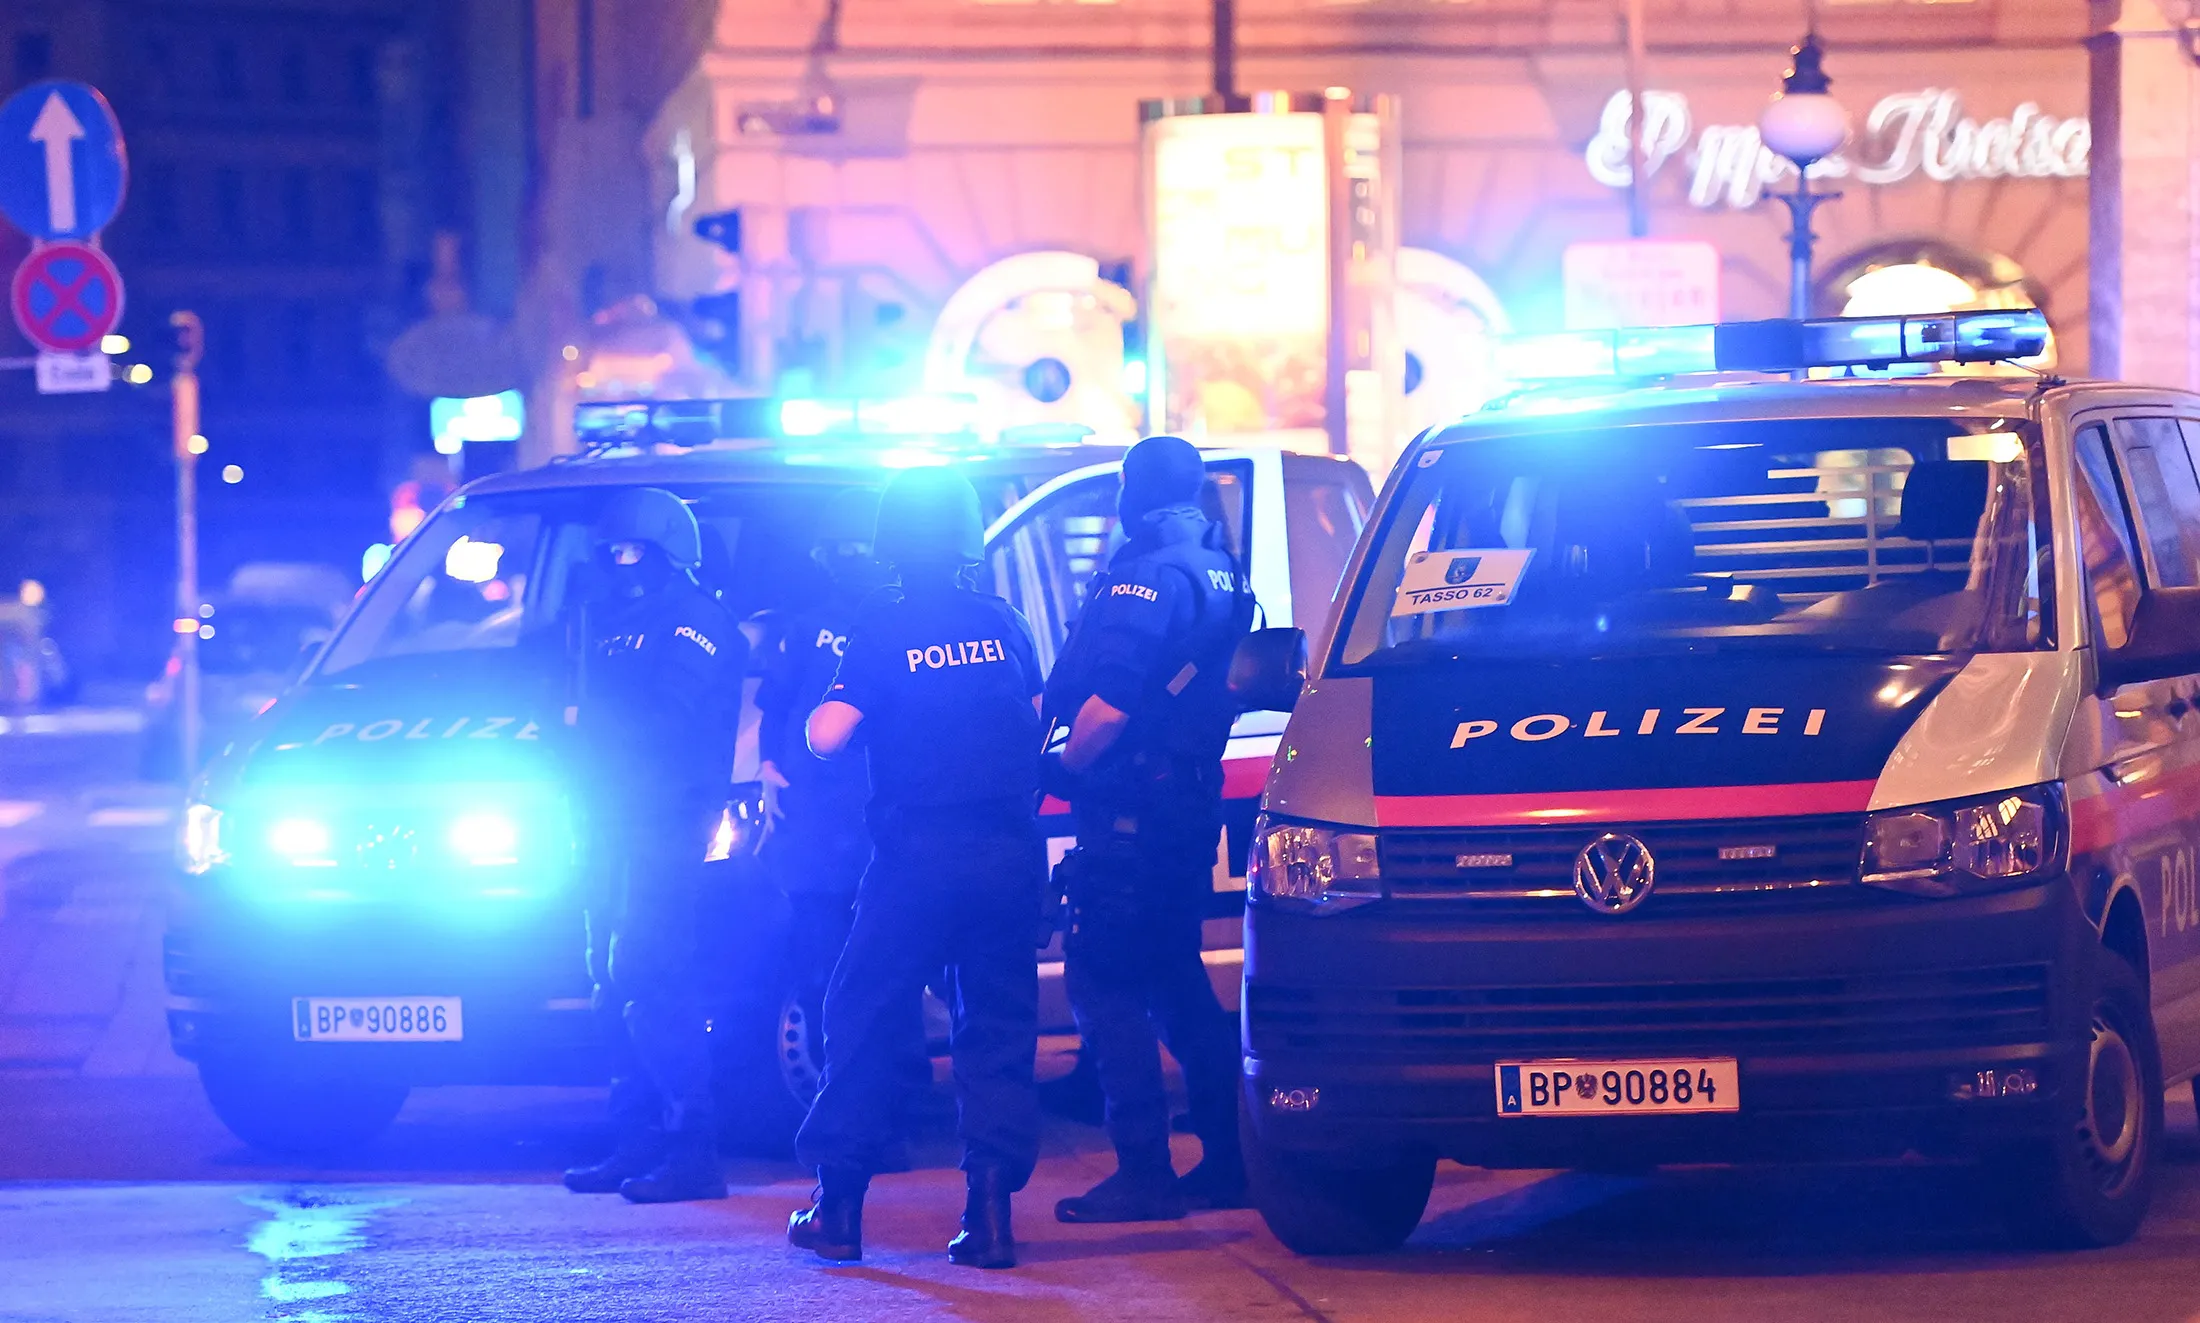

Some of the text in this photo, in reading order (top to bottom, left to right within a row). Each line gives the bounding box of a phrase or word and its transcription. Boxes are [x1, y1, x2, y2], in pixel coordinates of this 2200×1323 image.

[1111, 583, 1158, 602] POLIZEI
[1412, 587, 1494, 606] TASSO 62
[674, 626, 717, 656] POLIZEI
[906, 639, 1006, 673] POLIZEI
[1449, 707, 1827, 750] POLIZEI
[317, 1005, 447, 1034] BP 90886
[1507, 1094, 1517, 1107] A
[1529, 1068, 1717, 1107] BP 90884
